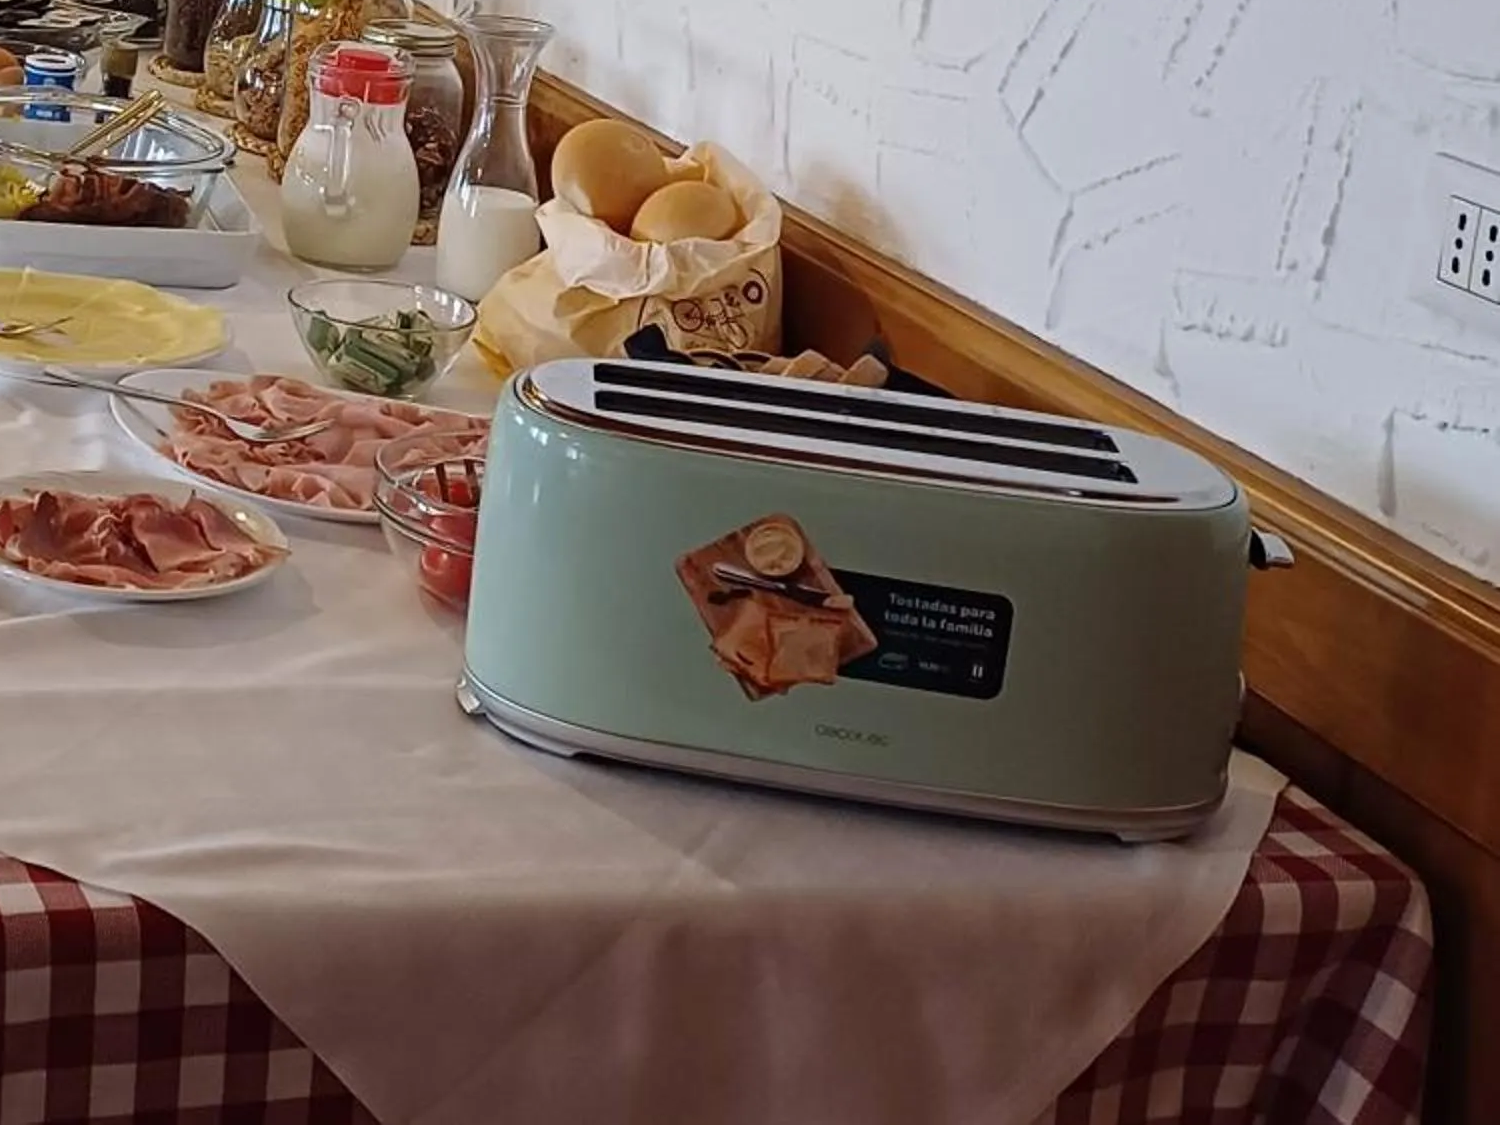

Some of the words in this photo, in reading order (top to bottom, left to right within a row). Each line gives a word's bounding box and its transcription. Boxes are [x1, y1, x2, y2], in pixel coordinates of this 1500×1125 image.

[889, 593, 957, 614] Tostadas
[960, 606, 996, 621] para
[884, 610, 919, 626] toda
[921, 616, 937, 629] la
[940, 618, 994, 638] familia
